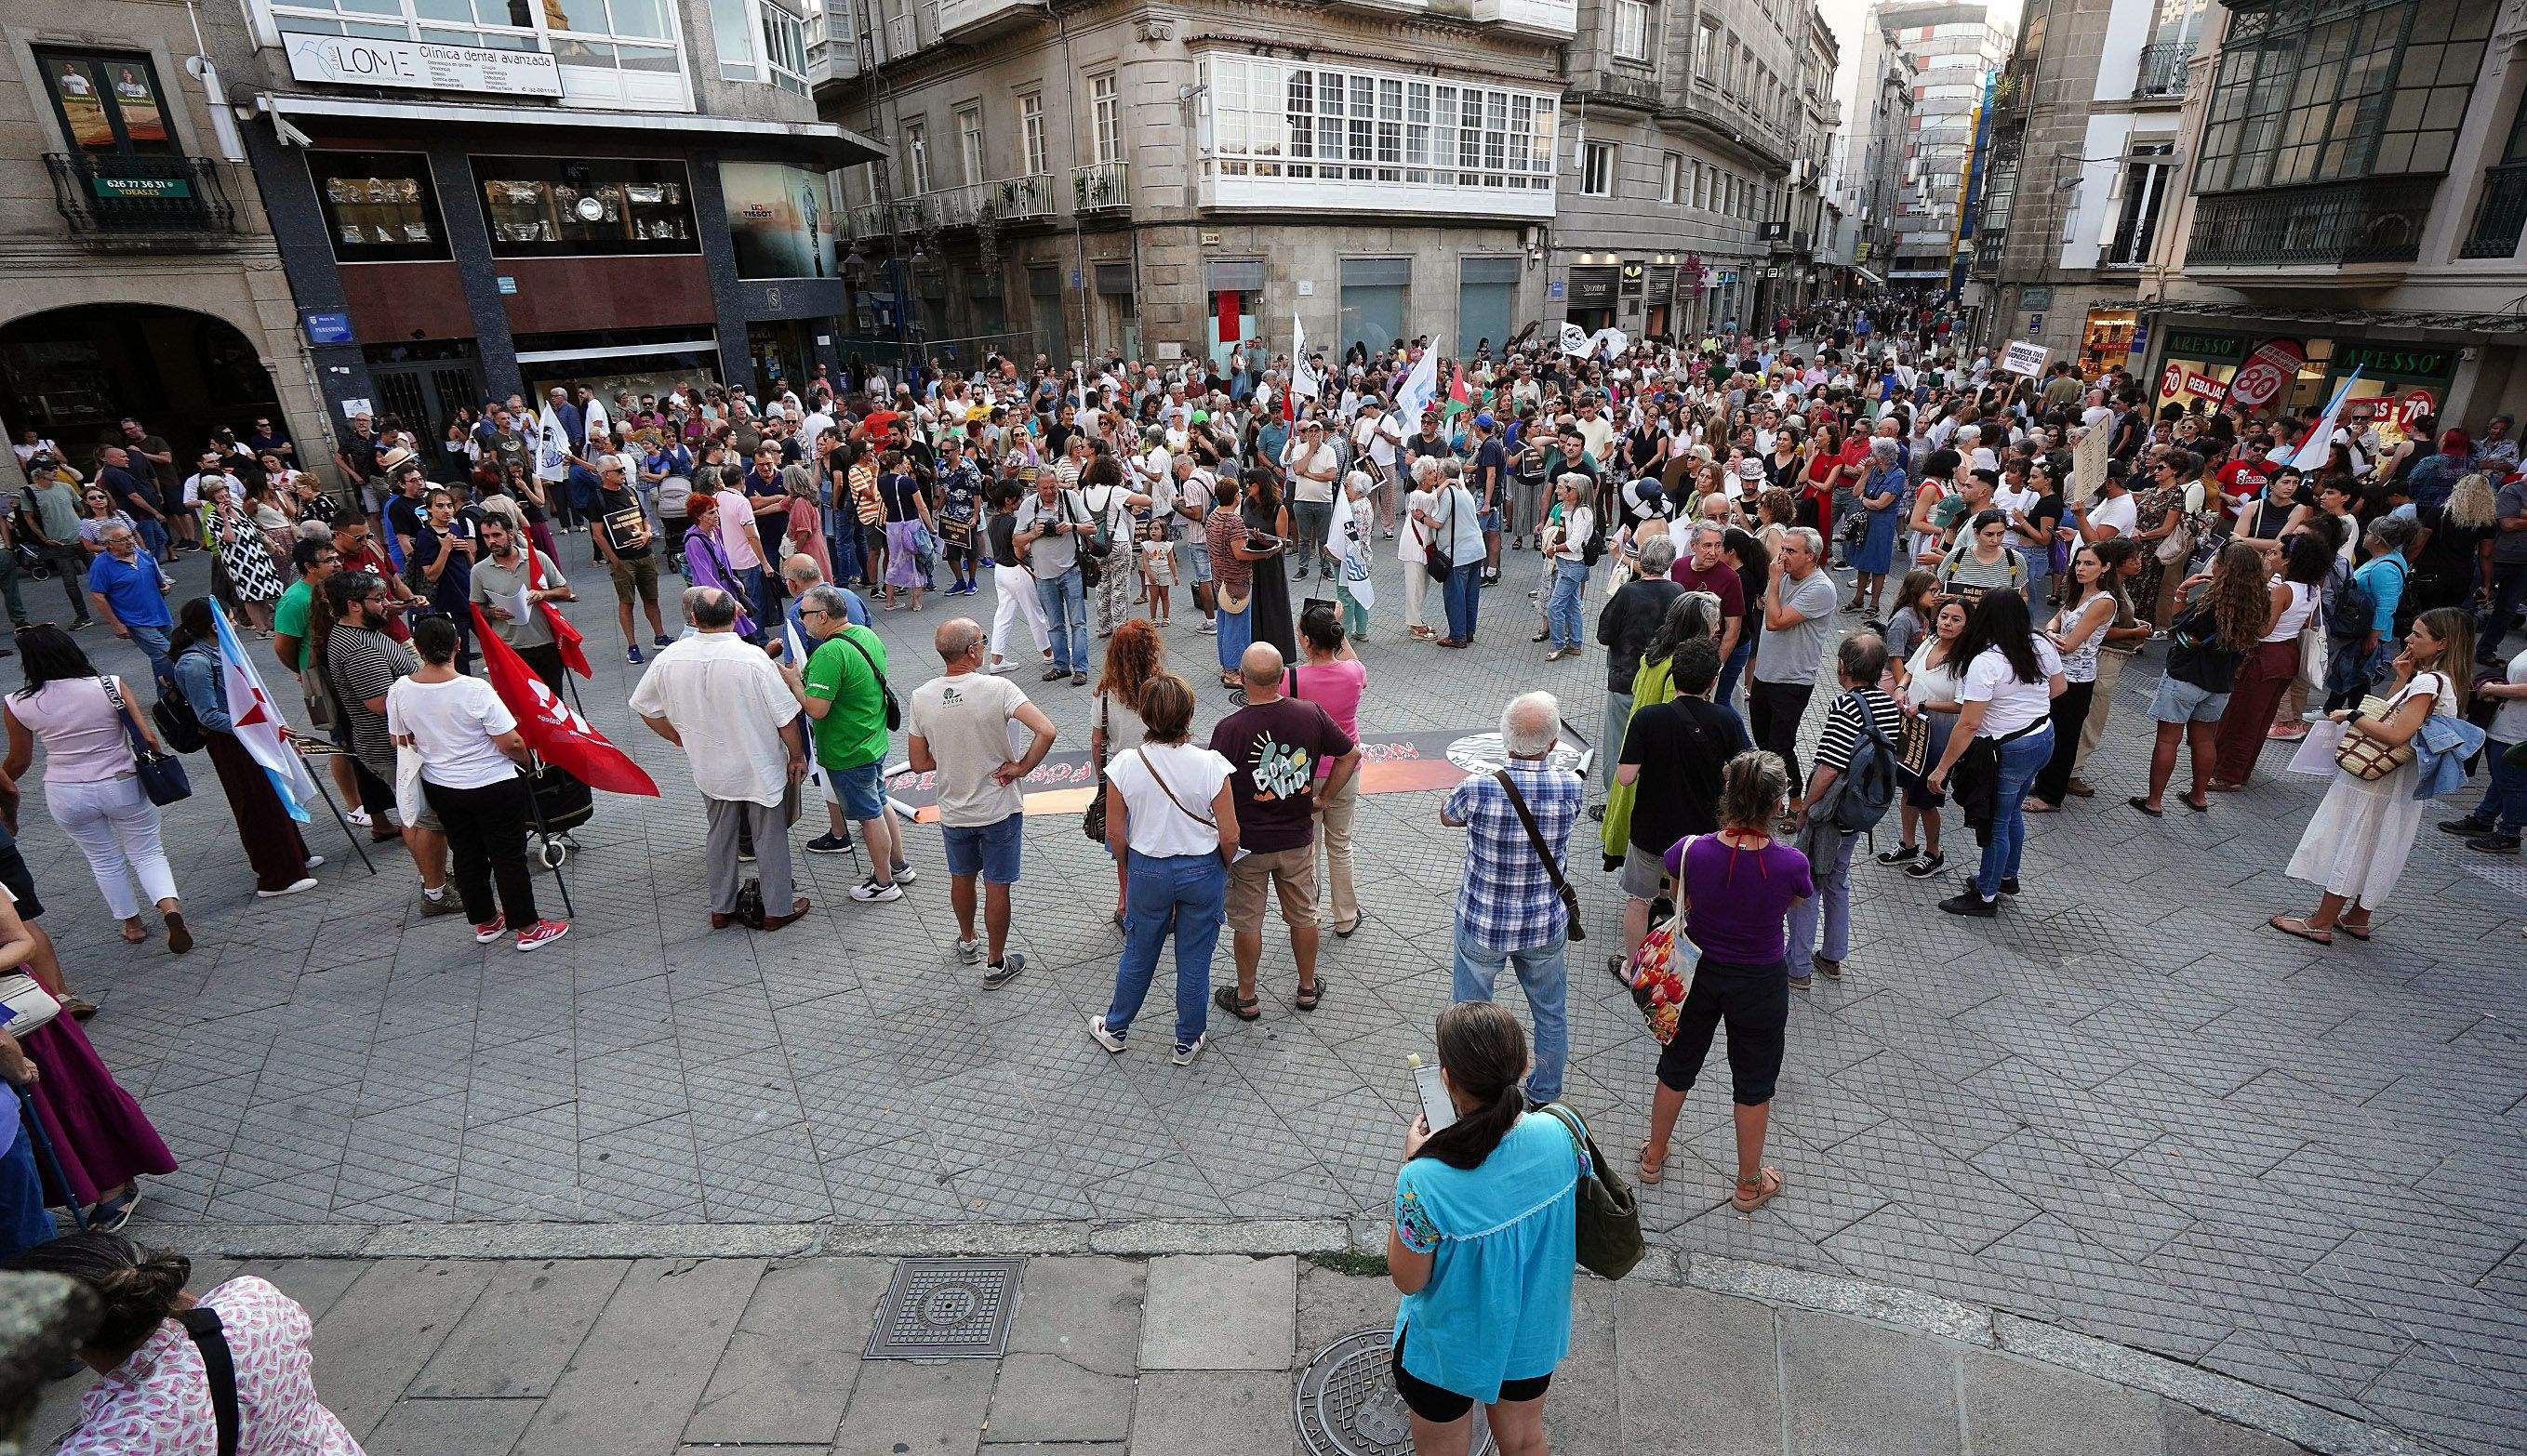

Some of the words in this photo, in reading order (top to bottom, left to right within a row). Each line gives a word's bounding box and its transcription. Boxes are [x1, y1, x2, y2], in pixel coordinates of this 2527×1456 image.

[336, 46, 416, 77] LOME
[419, 46, 460, 60] Clínica
[464, 50, 498, 63] dental
[501, 54, 552, 67] avanzada
[107, 179, 126, 189] 626
[126, 180, 140, 189] 77
[141, 180, 154, 189] 36
[155, 180, 166, 189] 31
[2010, 345, 2044, 359] MONOCULTIVO
[2171, 335, 2232, 355] ARESSO
[2006, 351, 2042, 364] MONOCULTURA
[2342, 349, 2438, 374] ARESSO
[2163, 371, 2181, 390] 70
[2235, 368, 2277, 400] 80
[2401, 400, 2430, 424] 70
[942, 697, 964, 706] ADEGA
[1903, 740, 1916, 764] RURAL
[1252, 755, 1292, 792] BOA
